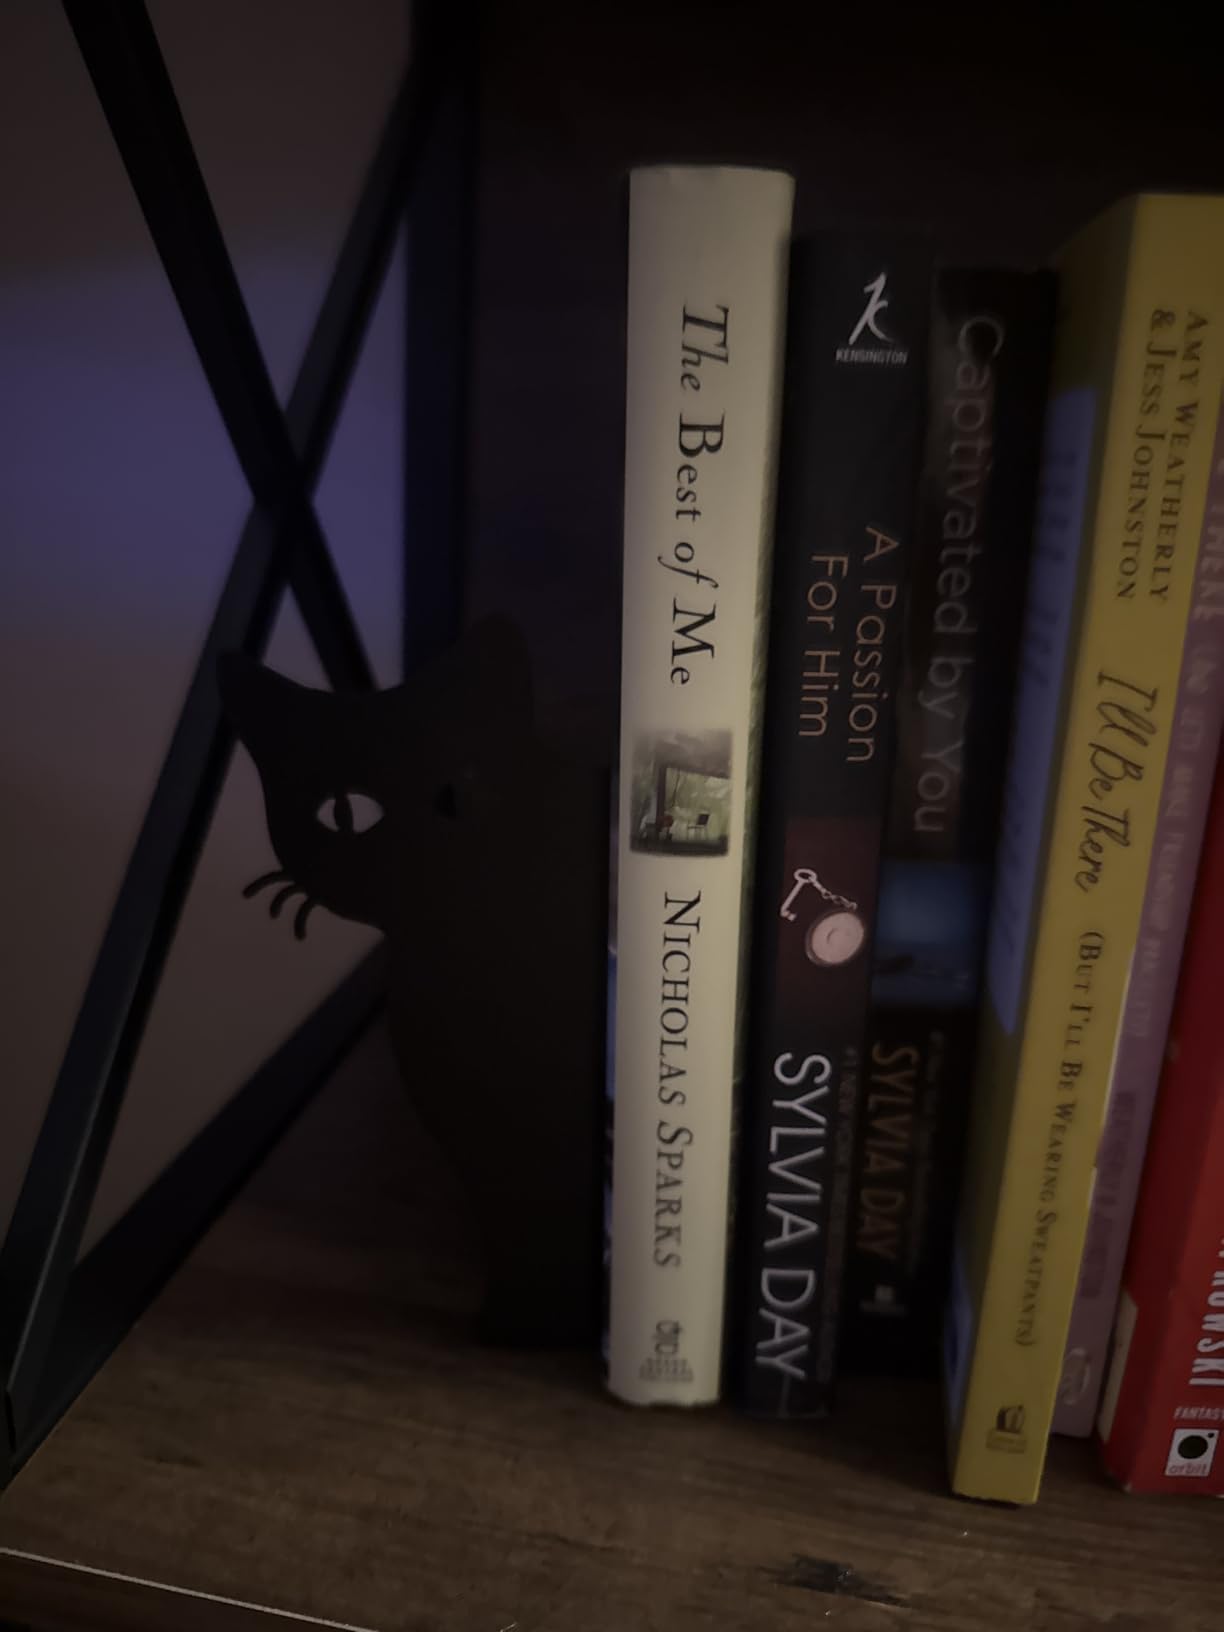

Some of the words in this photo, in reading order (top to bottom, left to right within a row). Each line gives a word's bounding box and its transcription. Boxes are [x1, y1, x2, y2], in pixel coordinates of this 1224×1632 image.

[681, 304, 729, 391] The
[1151, 309, 1177, 332] &
[1179, 310, 1208, 387] AMY
[1139, 341, 1177, 415] JESS
[675, 412, 725, 522] Best
[933, 314, 1005, 634] Captivated
[1149, 400, 1200, 603] WEATHERLY
[863, 525, 900, 563] A
[1117, 424, 1167, 599] JOHNSTON
[658, 542, 719, 588] of
[806, 553, 850, 631] For
[671, 597, 717, 685] Me
[846, 583, 897, 762] Passion
[798, 649, 841, 736] Him
[917, 655, 976, 720] by
[913, 739, 965, 832] You
[1088, 743, 1145, 800] Be
[1075, 806, 1131, 892] There
[659, 891, 701, 1106] NICHOLAS
[1074, 931, 1104, 994] (BUT
[1064, 1003, 1095, 1049] I'LL
[862, 1042, 921, 1175] SYLVIA
[1057, 1061, 1083, 1090] BE
[762, 1052, 833, 1250] SYLVIA
[1040, 1100, 1076, 1201] WEARING
[654, 1121, 693, 1268] SPARKS
[855, 1186, 907, 1262] DAY
[1015, 1209, 1057, 1347] SWEATPANTS)
[754, 1267, 818, 1382] DAY
